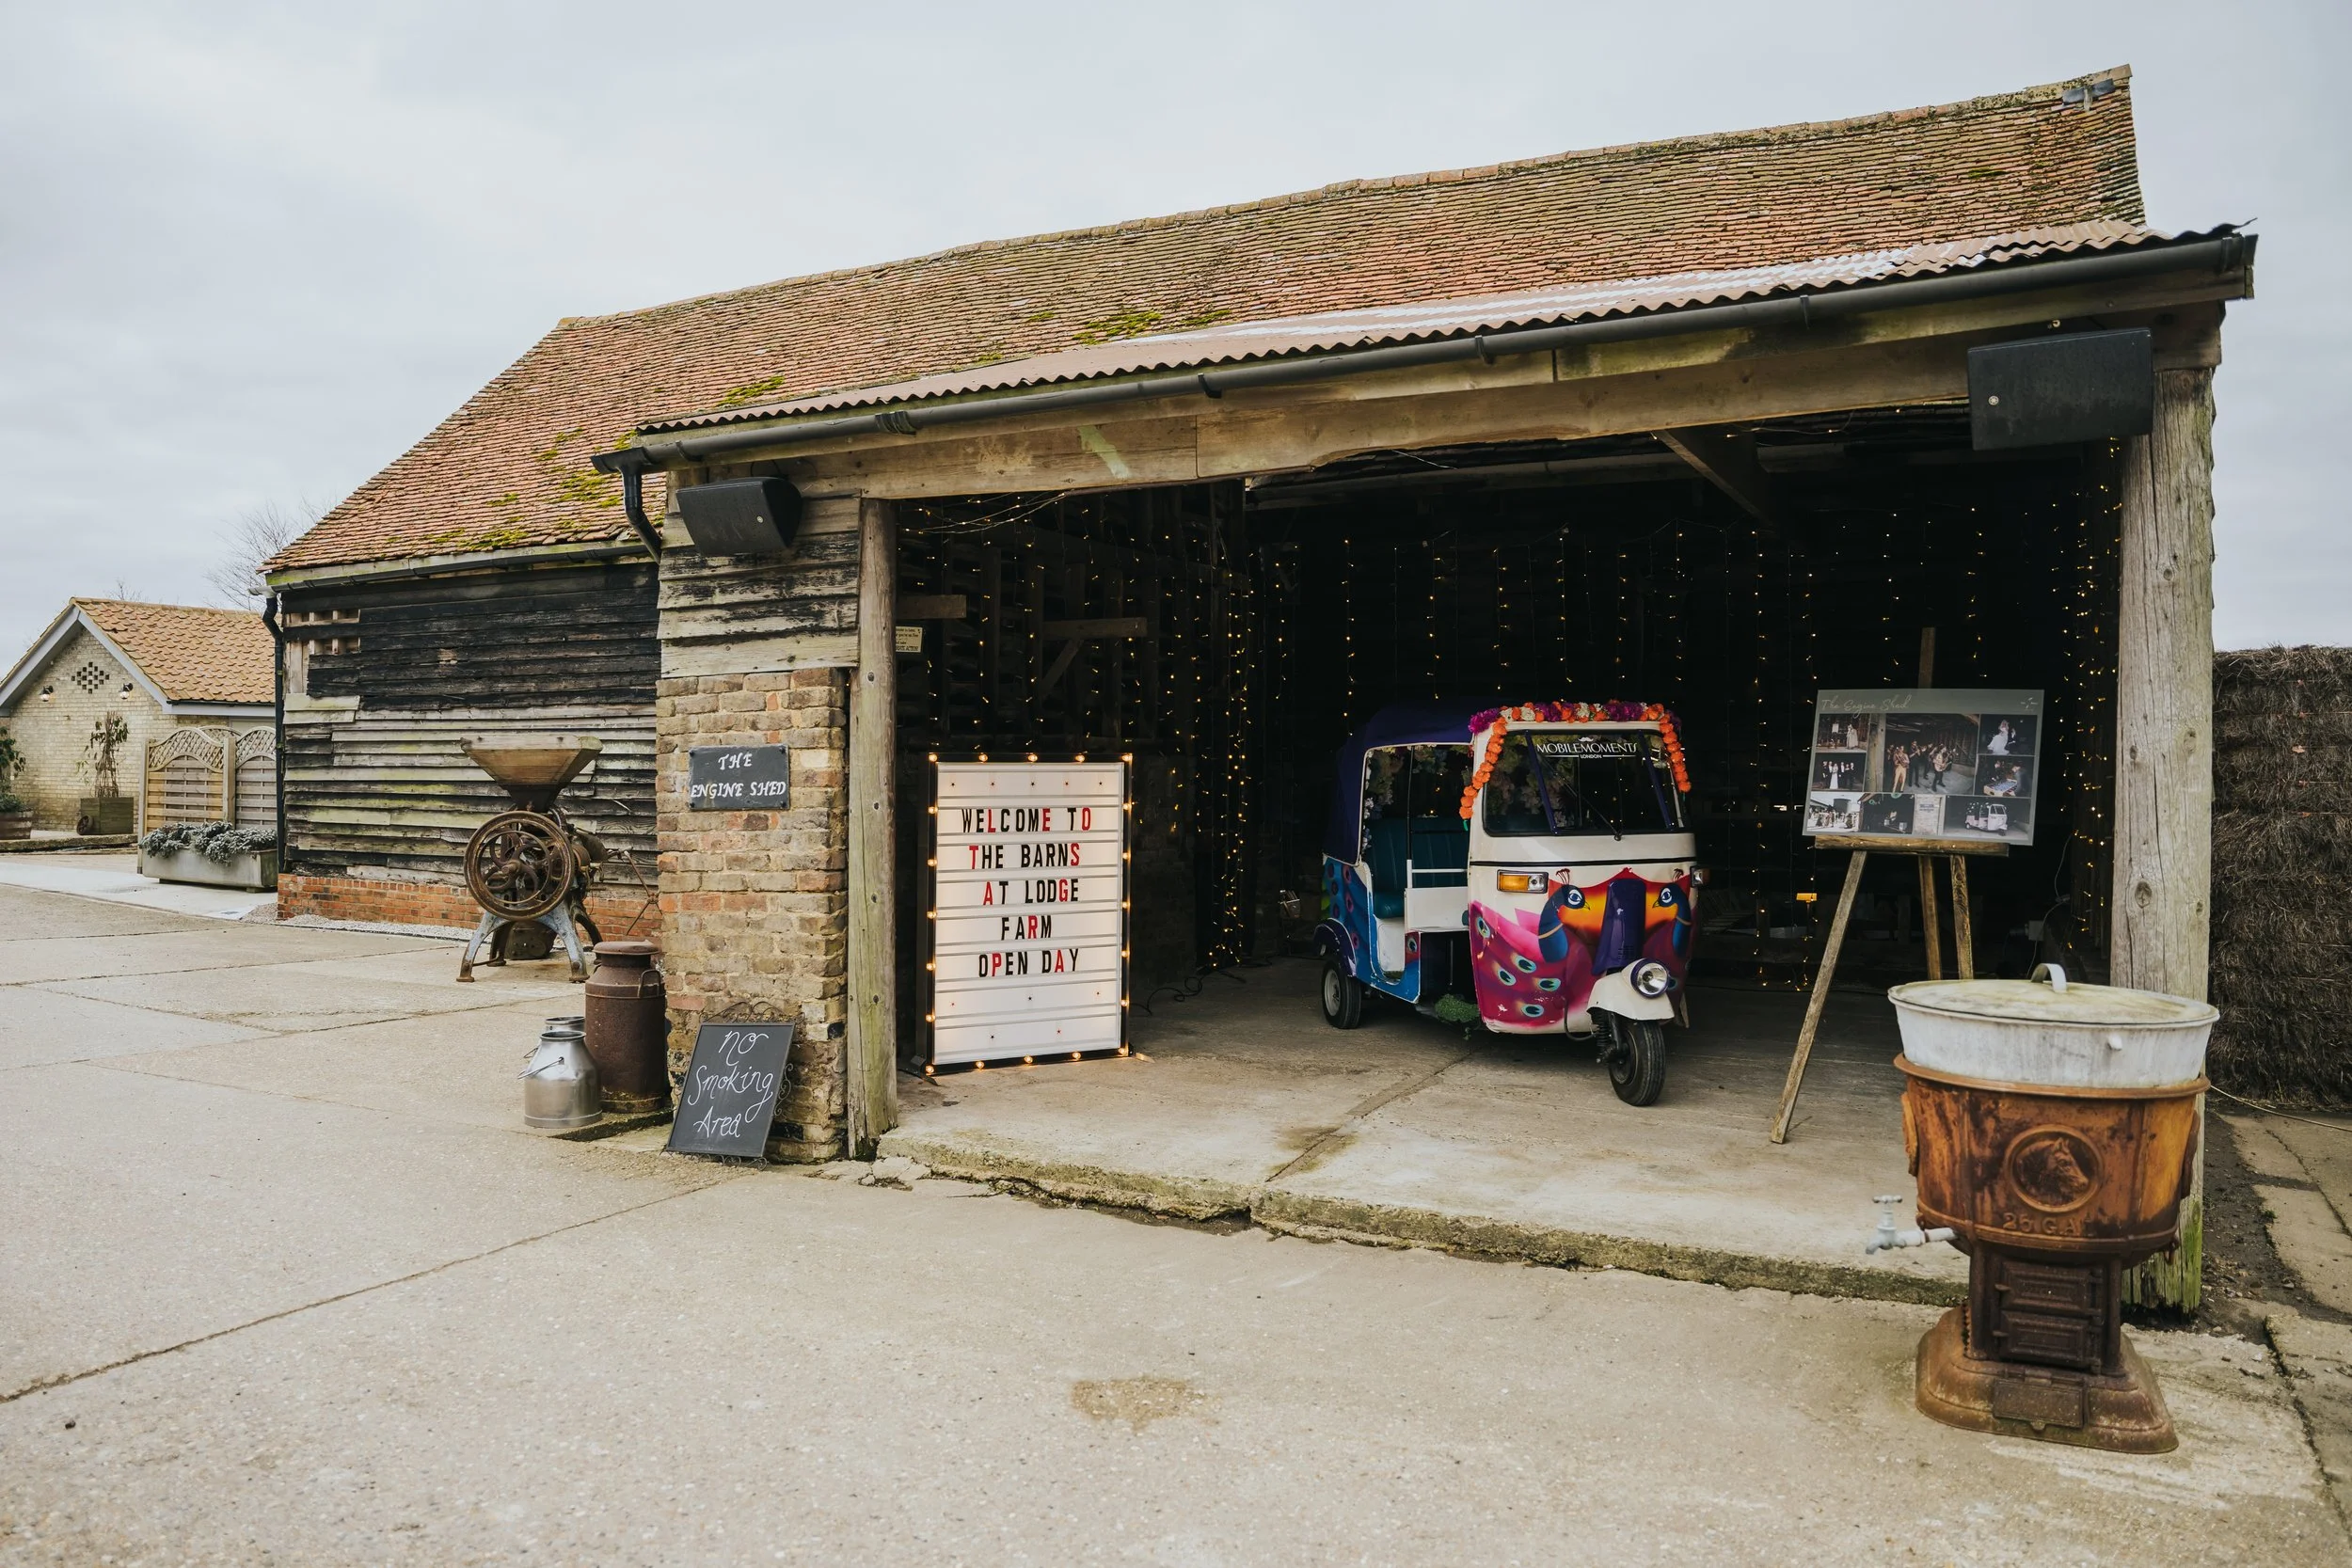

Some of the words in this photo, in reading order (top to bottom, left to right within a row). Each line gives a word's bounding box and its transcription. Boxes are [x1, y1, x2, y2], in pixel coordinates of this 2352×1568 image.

[1821, 694, 1839, 711] The
[1843, 699, 1877, 719] Engine
[1880, 693, 1913, 711] Shed
[1536, 742, 1638, 753] MOBILEMOMENTS
[718, 752, 754, 771] THE
[691, 782, 745, 800] ENGINE
[749, 781, 787, 797] SHED
[961, 807, 1052, 833] WELCOME
[1067, 806, 1091, 832] TO
[968, 845, 1004, 870] THE
[1021, 842, 1080, 867] BARNS
[982, 880, 1009, 906] AT
[1025, 878, 1079, 904] LODGE
[1001, 915, 1052, 941] FARM
[978, 951, 1028, 977] OPEN
[1041, 948, 1079, 974] DAY
[688, 1065, 774, 1123] Smoking
[692, 1105, 742, 1138] Area
[2002, 1212, 2032, 1233] 25
